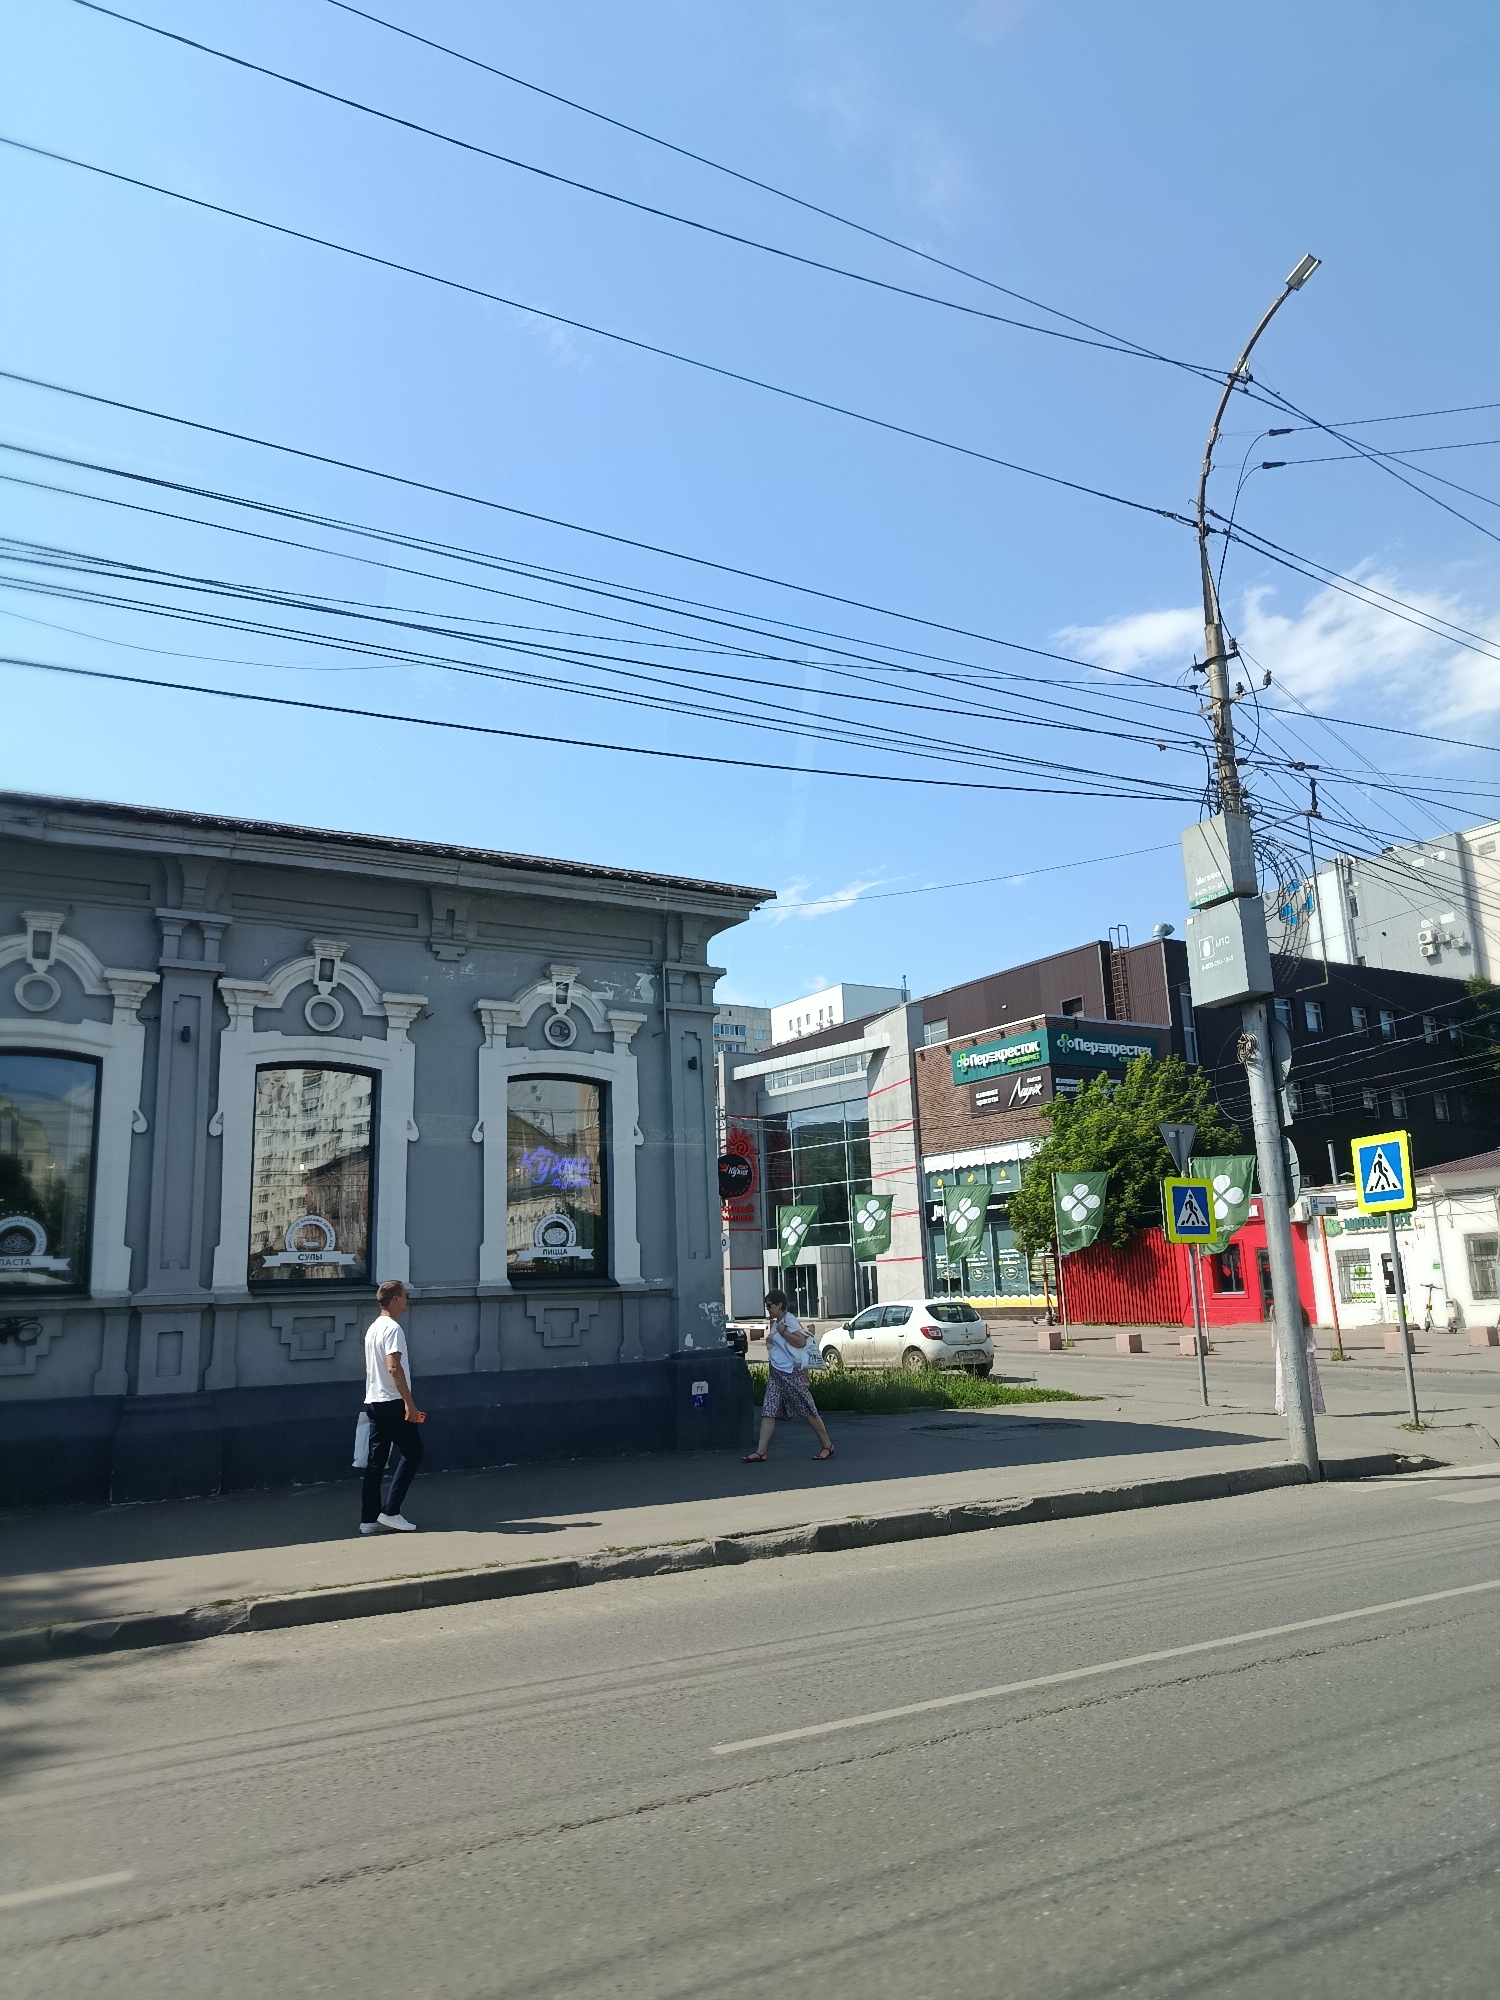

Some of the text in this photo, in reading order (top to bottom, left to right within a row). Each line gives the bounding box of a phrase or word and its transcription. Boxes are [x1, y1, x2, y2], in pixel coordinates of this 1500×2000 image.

[1216, 935, 1230, 947] МТС
[542, 1248, 568, 1256] ПИЦЦА
[0, 1258, 31, 1266] ПАСТА
